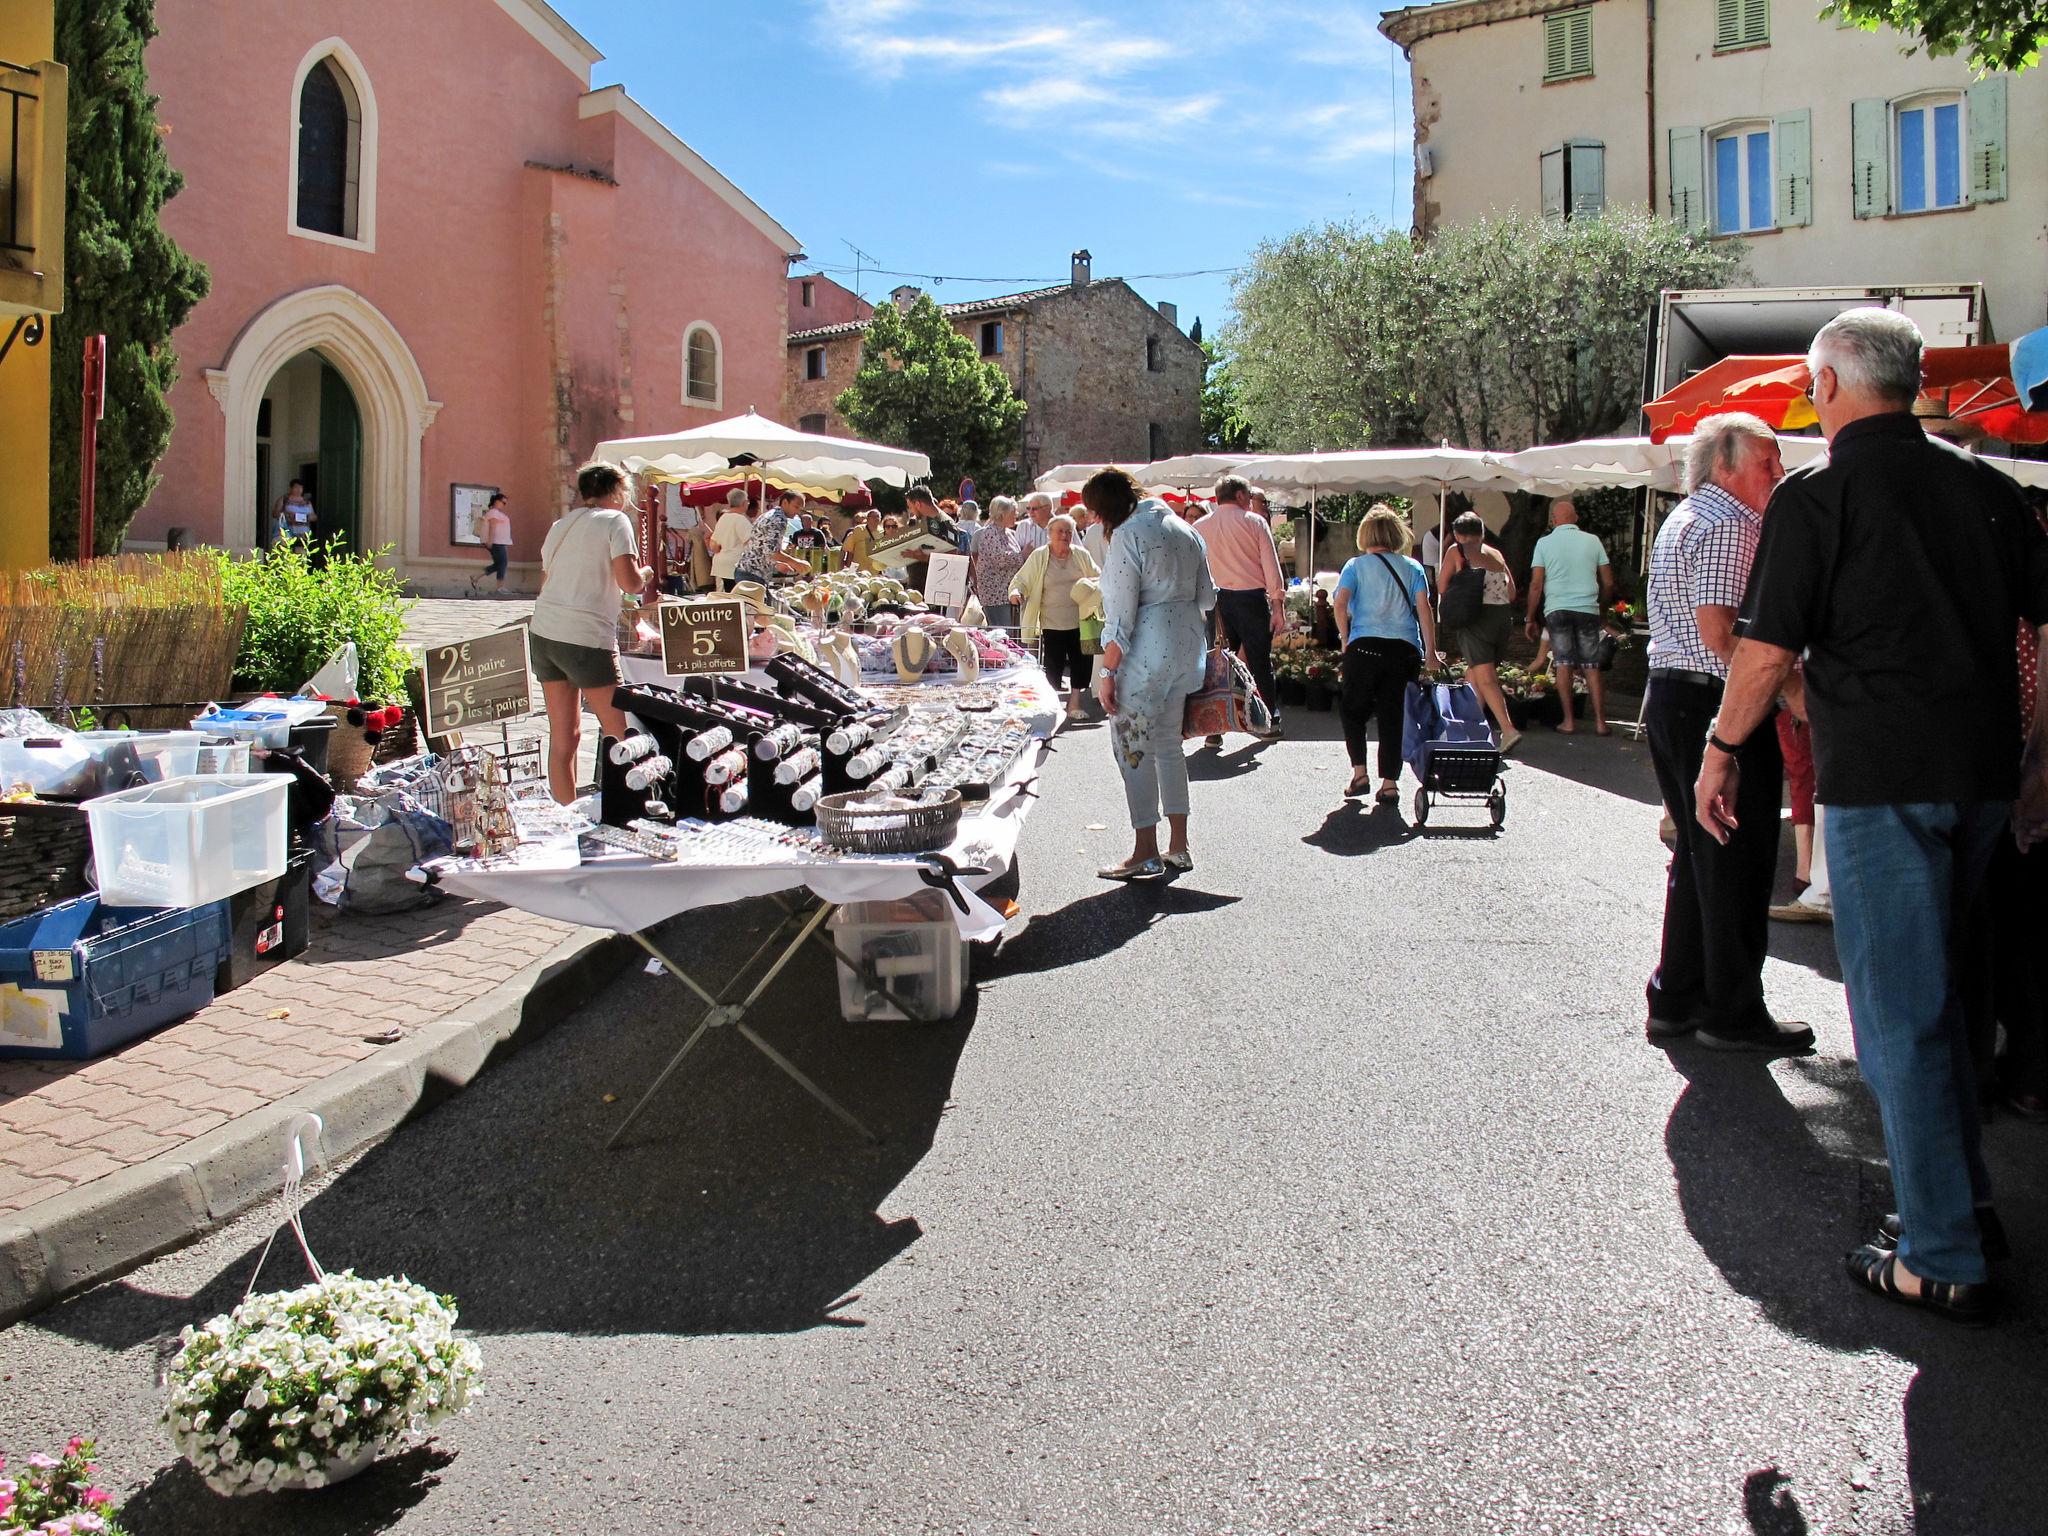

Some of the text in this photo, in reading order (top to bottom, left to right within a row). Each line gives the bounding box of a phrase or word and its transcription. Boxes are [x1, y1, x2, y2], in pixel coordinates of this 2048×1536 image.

[668, 605, 733, 627] Montre
[692, 629, 722, 656] 5€
[440, 643, 472, 685] 2€
[463, 658, 506, 677] la paire
[676, 659, 736, 671] +1 pile offerte
[444, 685, 476, 726] 5€
[467, 696, 529, 719] les 3 paires
